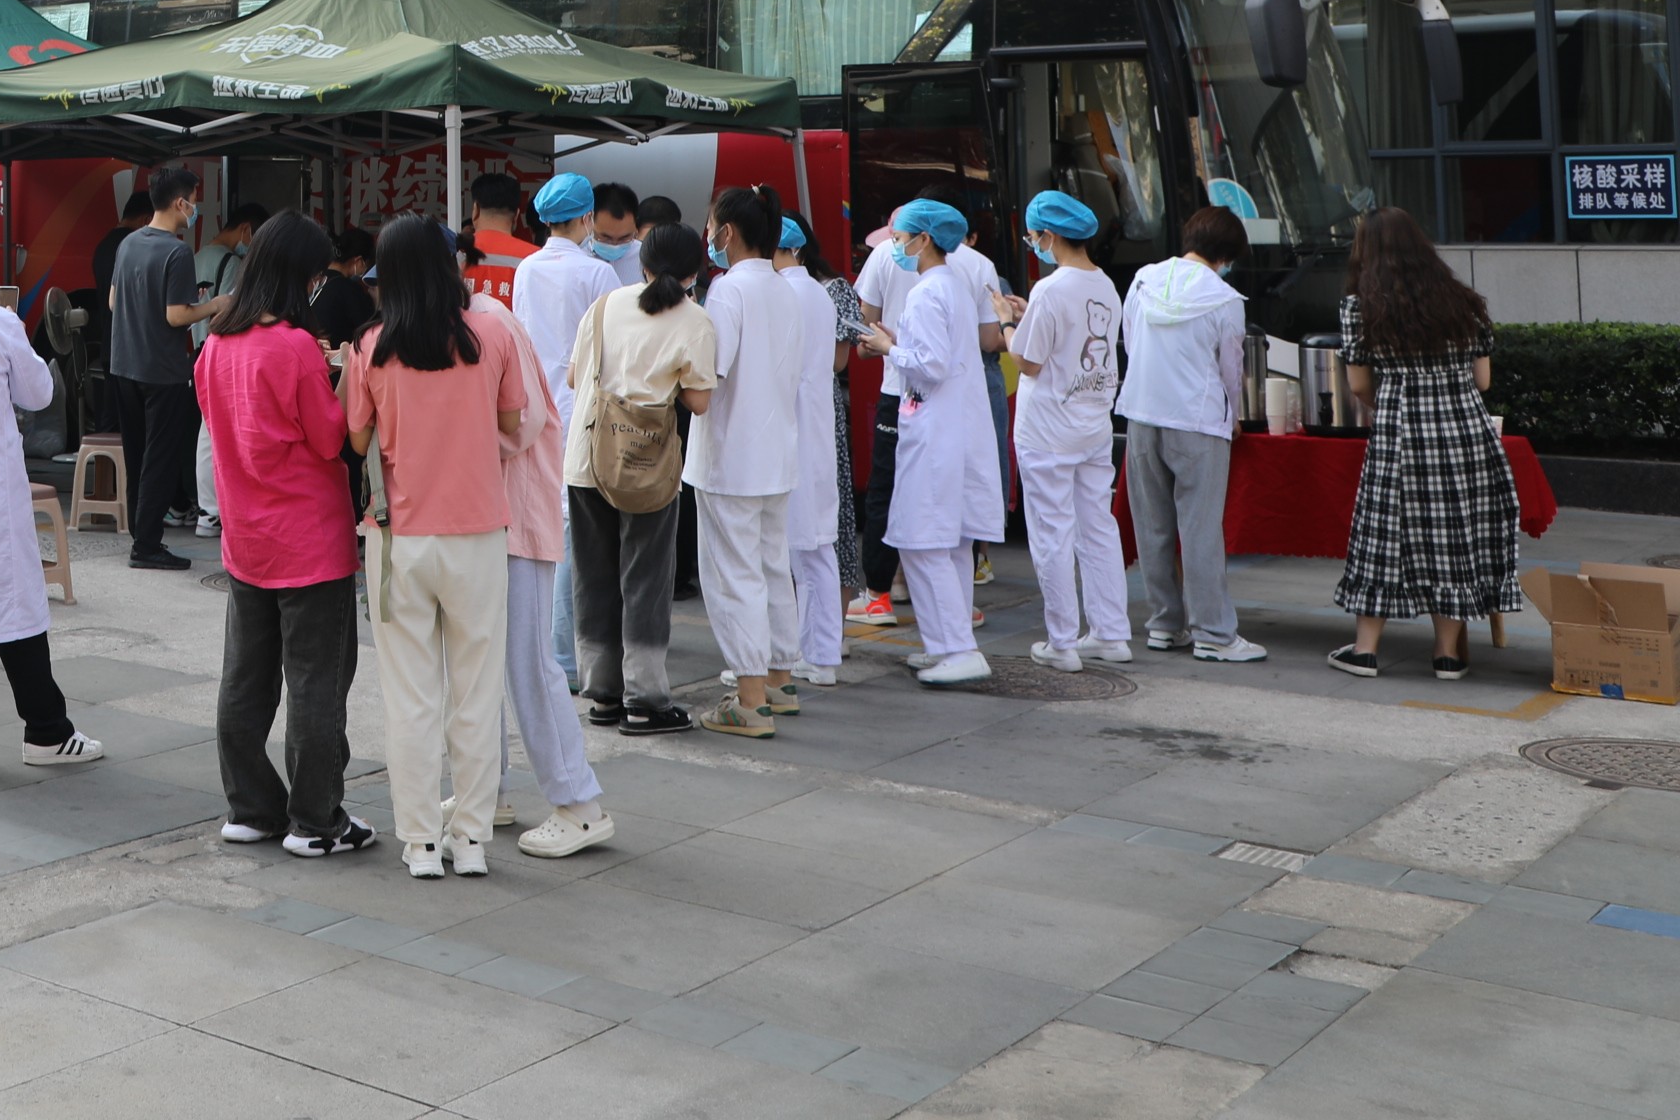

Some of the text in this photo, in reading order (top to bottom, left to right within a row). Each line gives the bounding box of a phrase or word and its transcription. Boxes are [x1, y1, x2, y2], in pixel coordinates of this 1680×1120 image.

[210, 34, 348, 58] 无偿献血
[212, 75, 310, 100] 拯救生命
[1572, 163, 1667, 190] 核酸采样
[1578, 192, 1667, 210] 排队等候处
